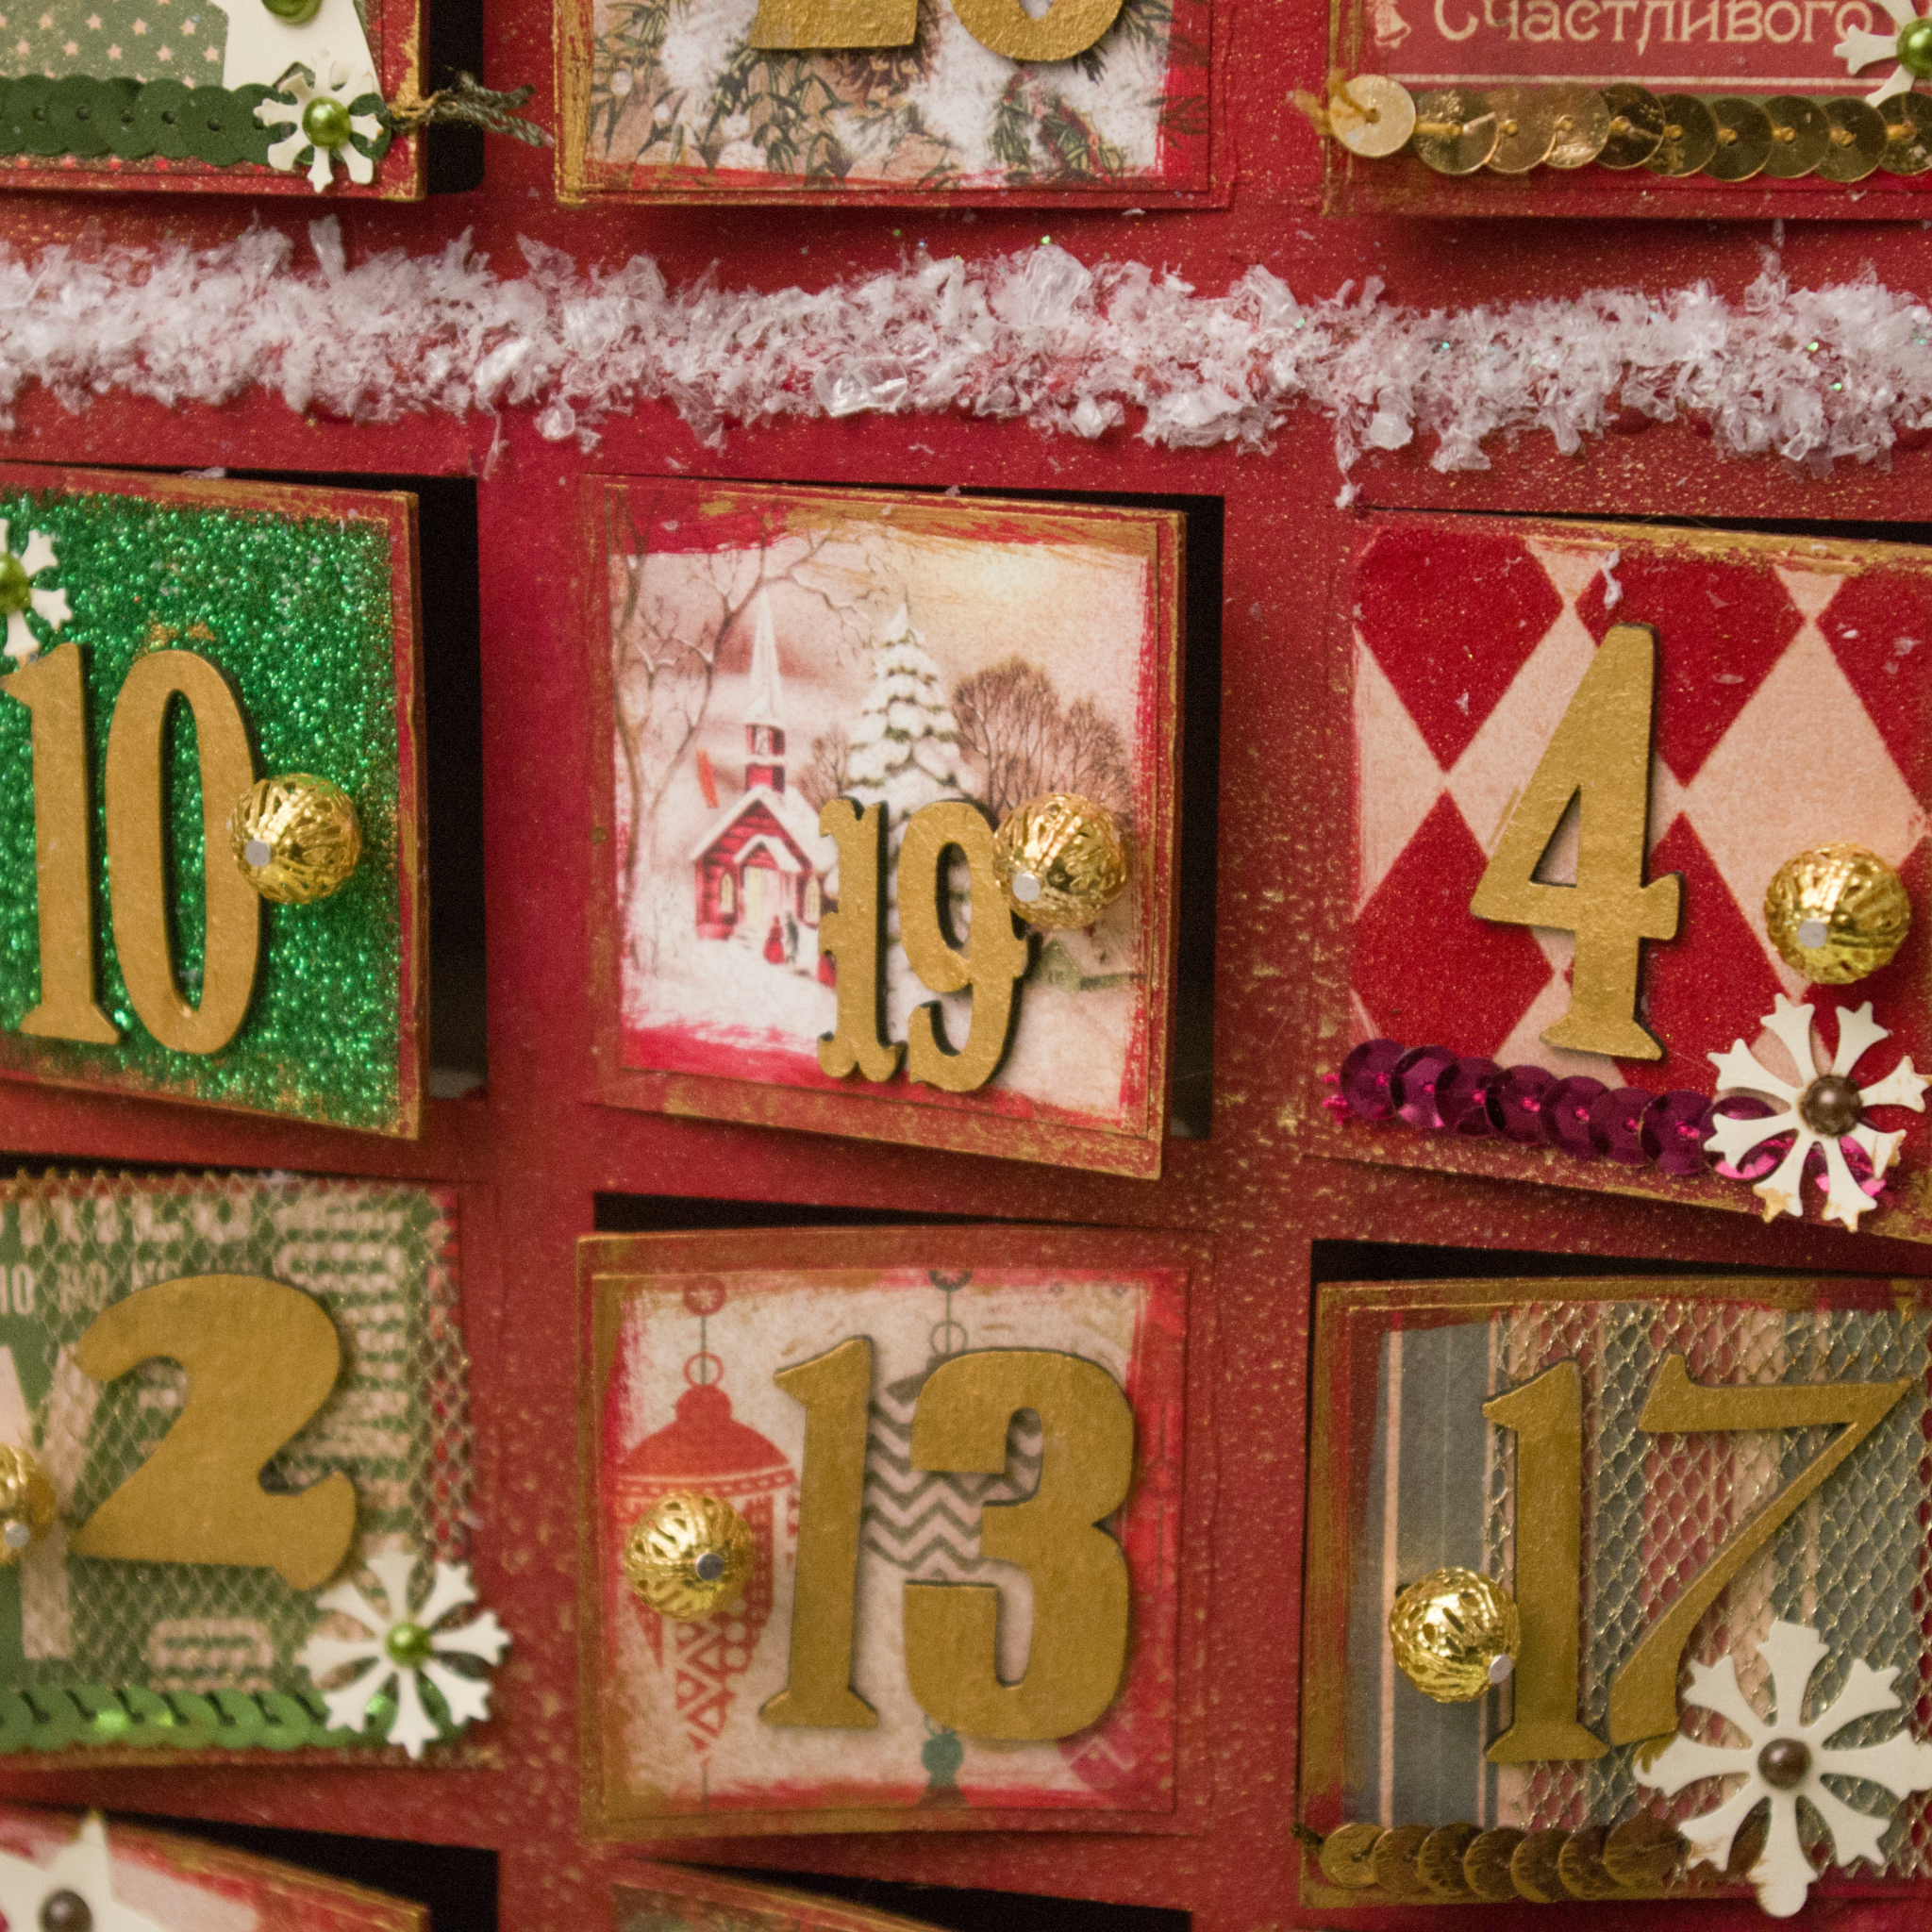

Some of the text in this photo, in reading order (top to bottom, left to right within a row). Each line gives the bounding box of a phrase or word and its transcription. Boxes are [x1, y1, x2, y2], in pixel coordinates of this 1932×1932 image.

[3, 641, 264, 1054] 10
[817, 795, 1030, 1093] 19
[1470, 622, 1682, 1061] 4
[69, 1273, 357, 1591] 2
[758, 1333, 1135, 1740] 13
[1482, 1351, 1913, 1763] 17
